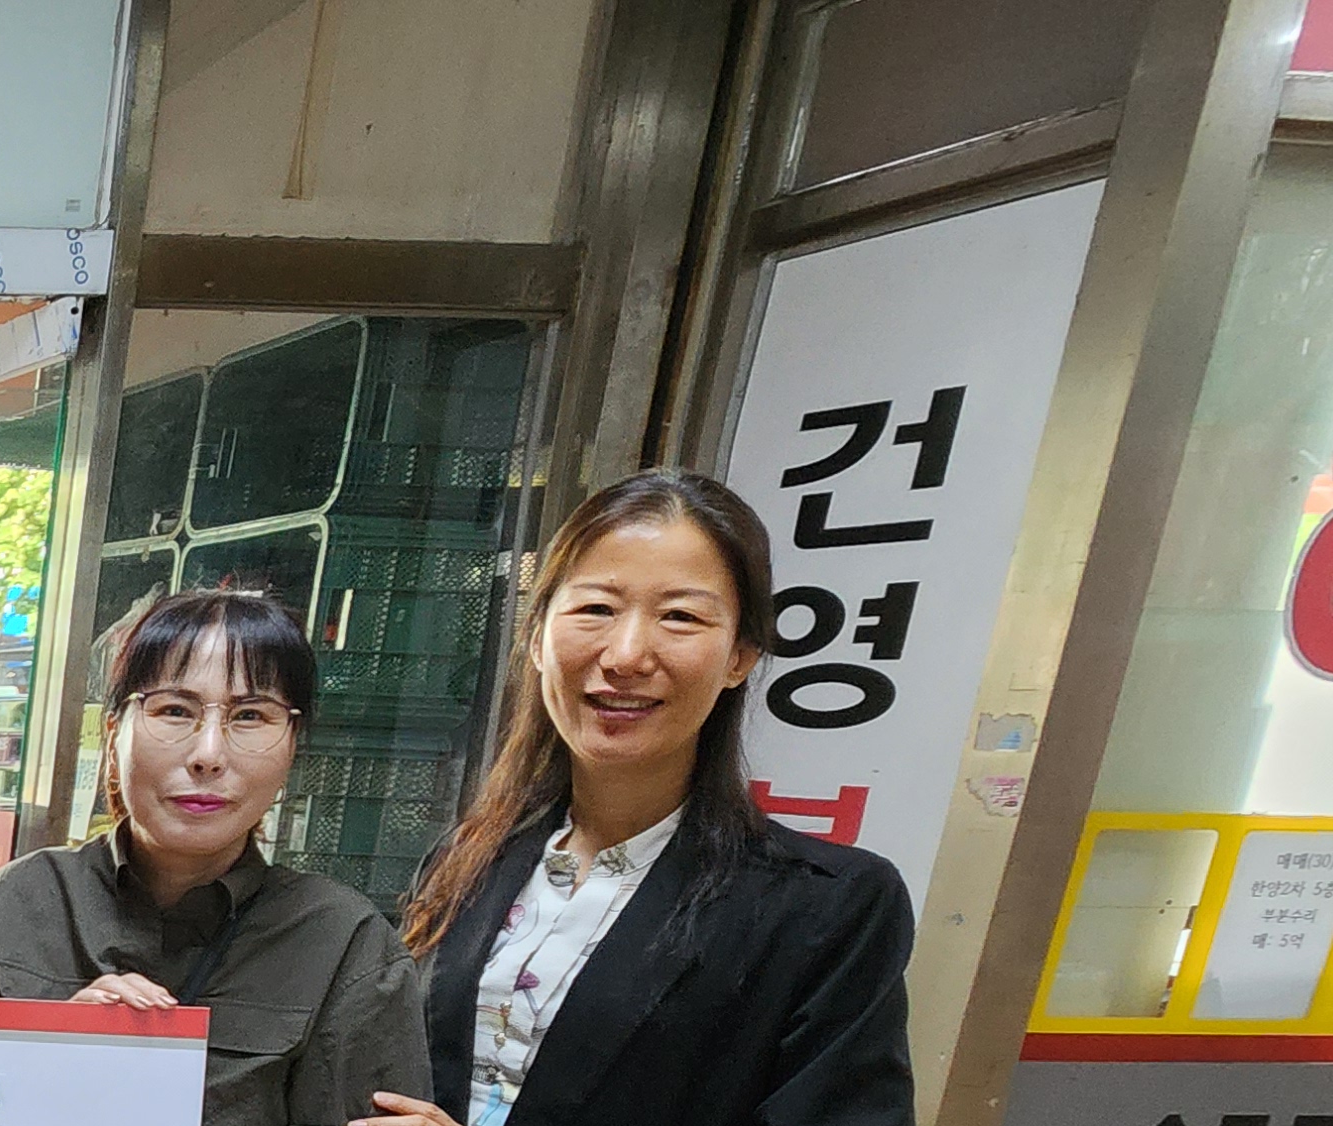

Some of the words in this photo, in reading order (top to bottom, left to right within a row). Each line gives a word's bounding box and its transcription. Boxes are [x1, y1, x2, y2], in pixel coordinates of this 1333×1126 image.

[1251, 880, 1306, 898] 한양2차
[1261, 908, 1319, 924] 부분수리
[1278, 932, 1305, 949] 5억
